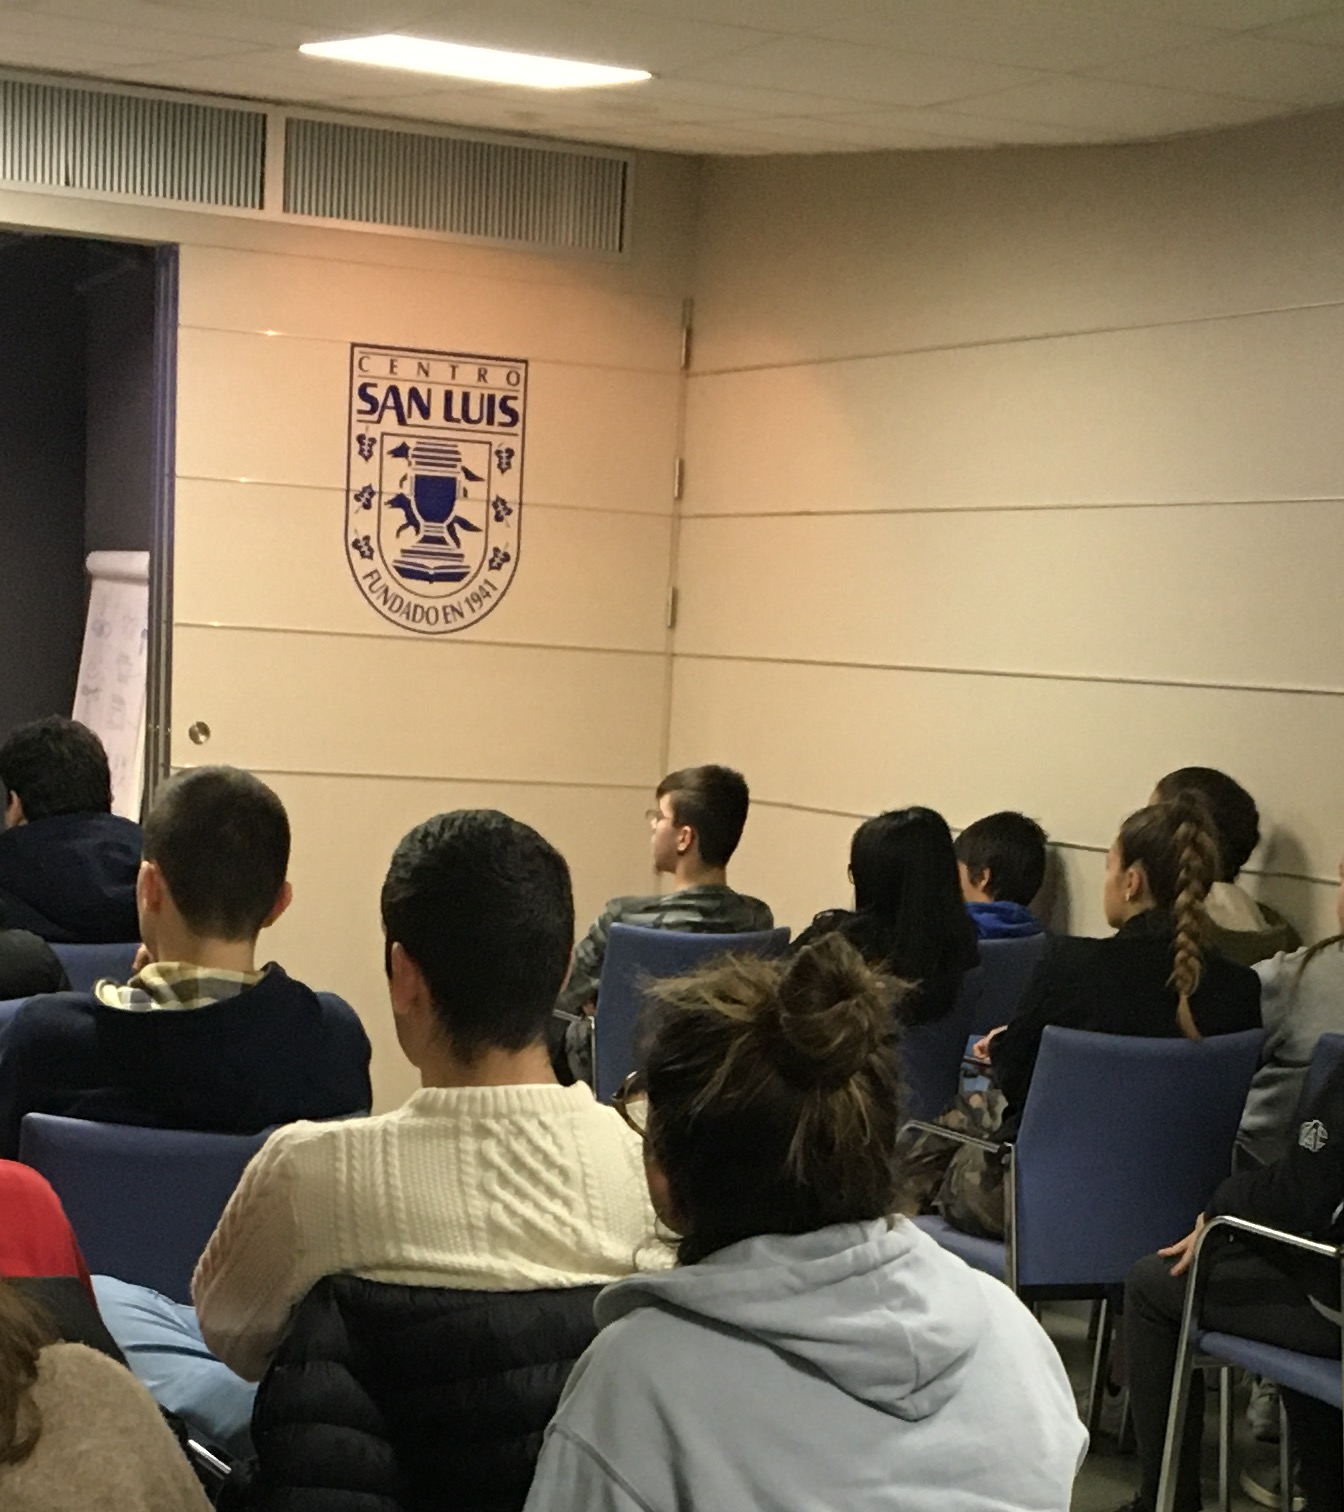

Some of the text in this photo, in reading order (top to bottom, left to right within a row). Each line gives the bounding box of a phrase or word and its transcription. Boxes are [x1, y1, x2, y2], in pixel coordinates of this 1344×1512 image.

[358, 355, 521, 388] CENTRO
[356, 381, 519, 428] SAN LUIS
[362, 568, 499, 626] FUNDADO EN 1941
